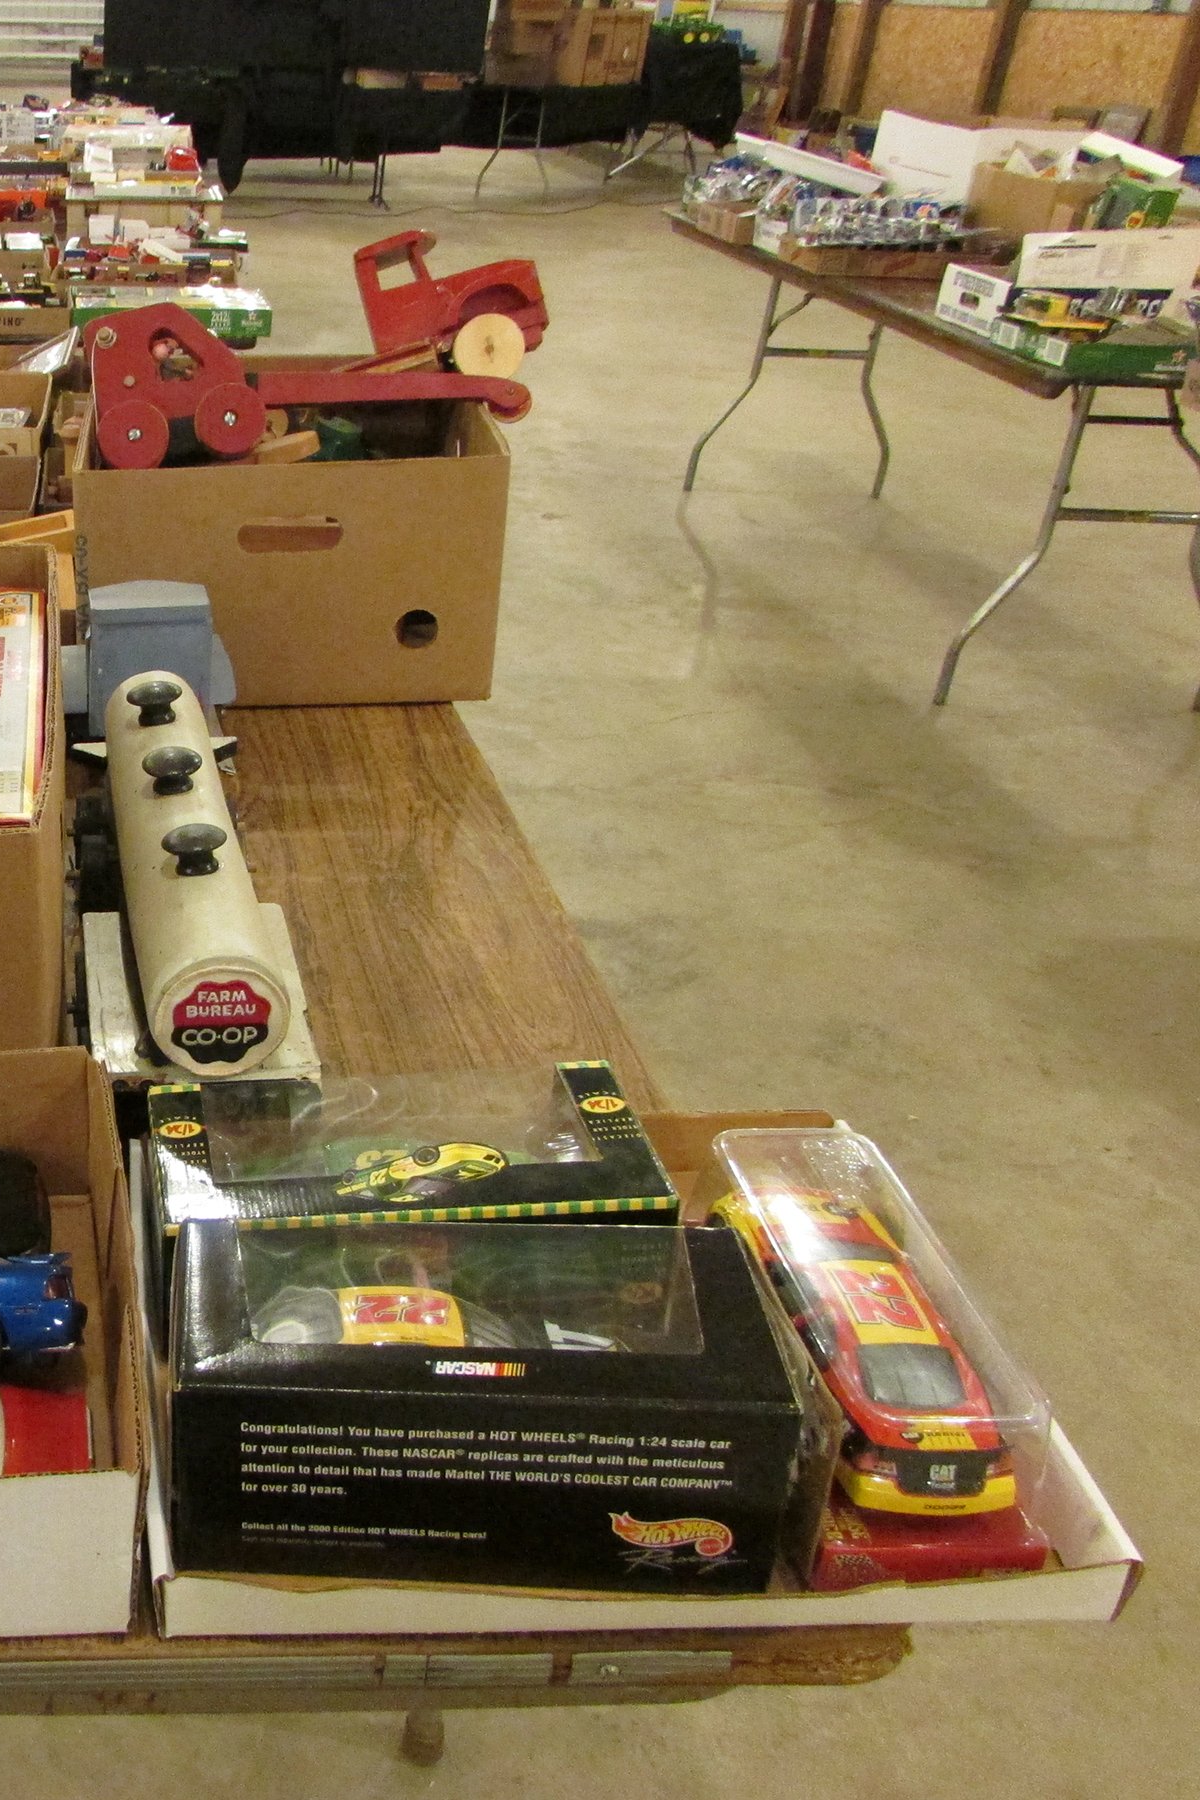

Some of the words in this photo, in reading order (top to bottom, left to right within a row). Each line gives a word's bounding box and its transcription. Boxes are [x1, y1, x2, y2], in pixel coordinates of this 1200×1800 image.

[197, 990, 247, 1003] FARM
[185, 1003, 257, 1018] BUREAU
[165, 1123, 195, 1136] 1/24
[830, 1268, 928, 1332] 22
[351, 1293, 452, 1327] 22
[434, 1360, 497, 1376] NASCAR
[240, 1421, 344, 1436] Congratulations!
[348, 1426, 370, 1437] You
[374, 1427, 404, 1438] have
[408, 1429, 474, 1440] purchased
[477, 1432, 486, 1440] a
[490, 1430, 517, 1441] HOT
[589, 1434, 634, 1447] Racing
[639, 1436, 666, 1447] 1:24
[671, 1438, 706, 1449] scale
[710, 1440, 732, 1449] car
[240, 1442, 257, 1452] for
[261, 1444, 288, 1455] your
[291, 1445, 357, 1456] collection.
[362, 1446, 398, 1457] These
[468, 1450, 519, 1462] replicas
[523, 1453, 543, 1462] are
[548, 1453, 592, 1464] crafted
[596, 1455, 624, 1465] with
[628, 1456, 648, 1466] the
[652, 1457, 725, 1469] meticulous
[241, 1463, 295, 1474] attention
[299, 1465, 311, 1474] to
[314, 1464, 349, 1475] detail
[353, 1466, 377, 1476] that
[380, 1467, 402, 1477] has
[406, 1468, 441, 1478] made
[445, 1469, 484, 1480] Mattel
[489, 1470, 511, 1481] THE
[515, 1471, 571, 1484] WORLD'S
[574, 1473, 629, 1486] COOLEST
[632, 1476, 657, 1487] CAR
[929, 1464, 957, 1481] CAT
[241, 1481, 258, 1492] for
[261, 1484, 288, 1493] over
[291, 1483, 306, 1493] 30
[310, 1485, 347, 1496] years.
[241, 1521, 274, 1531] Collect
[276, 1523, 288, 1531] all
[291, 1523, 305, 1531] the
[308, 1524, 330, 1533] 2000
[333, 1525, 365, 1534] Edition
[367, 1526, 386, 1535] HOT
[388, 1528, 426, 1537] WHEELS
[428, 1529, 460, 1539] Racing
[462, 1531, 487, 1540] cars!
[640, 1525, 676, 1544] Hot
[675, 1521, 727, 1541] Wheels
